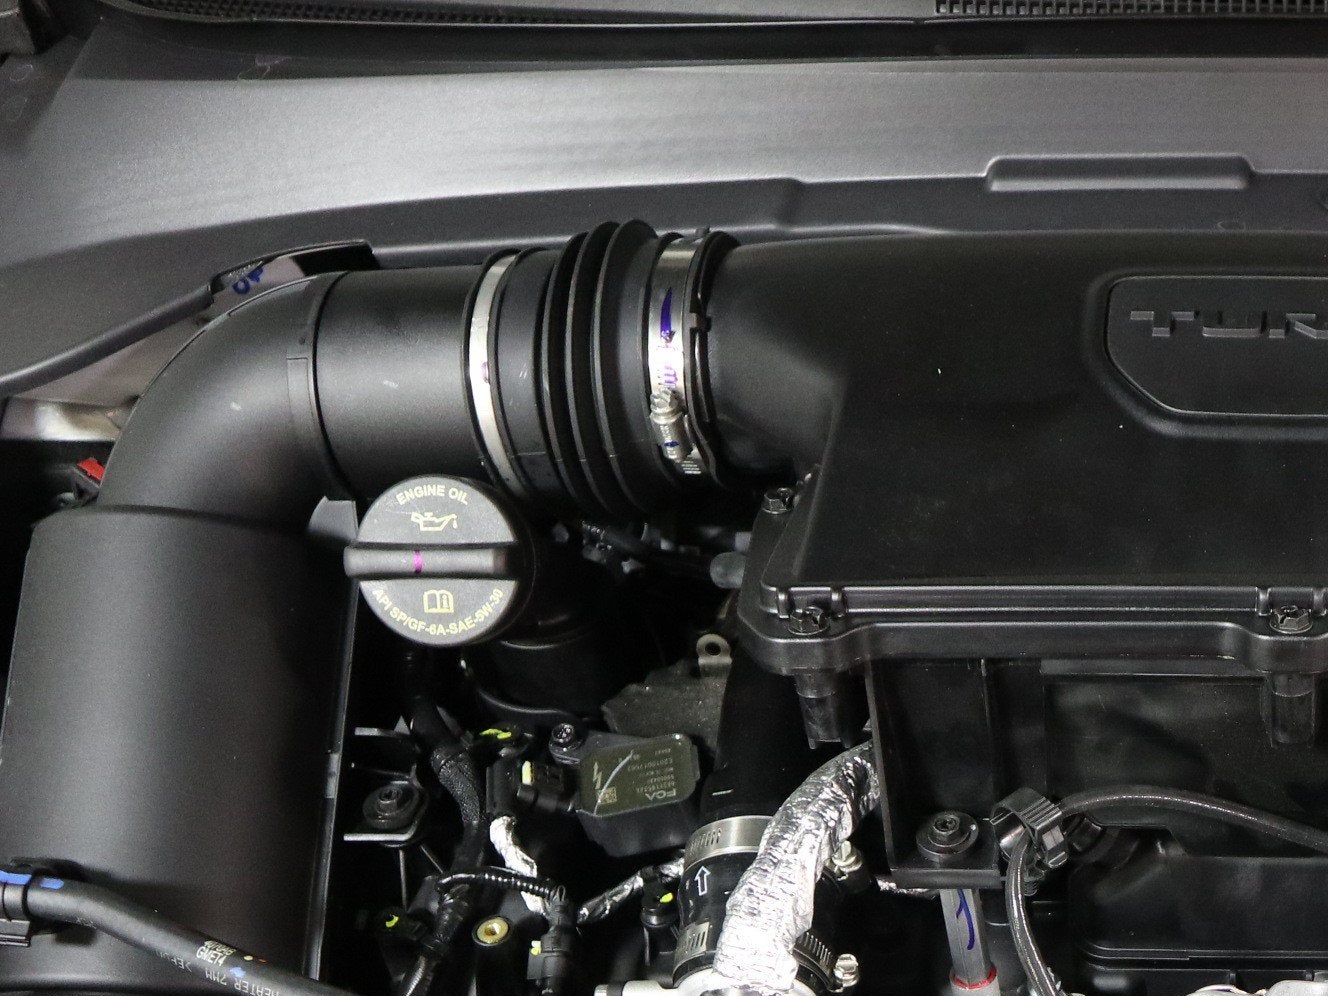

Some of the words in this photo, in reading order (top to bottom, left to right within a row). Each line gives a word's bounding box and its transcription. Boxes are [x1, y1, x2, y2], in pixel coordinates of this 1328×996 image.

[396, 485, 446, 505] ENGINE
[449, 488, 469, 505] OIL
[372, 588, 394, 612] API
[205, 967, 227, 986] 7MM
